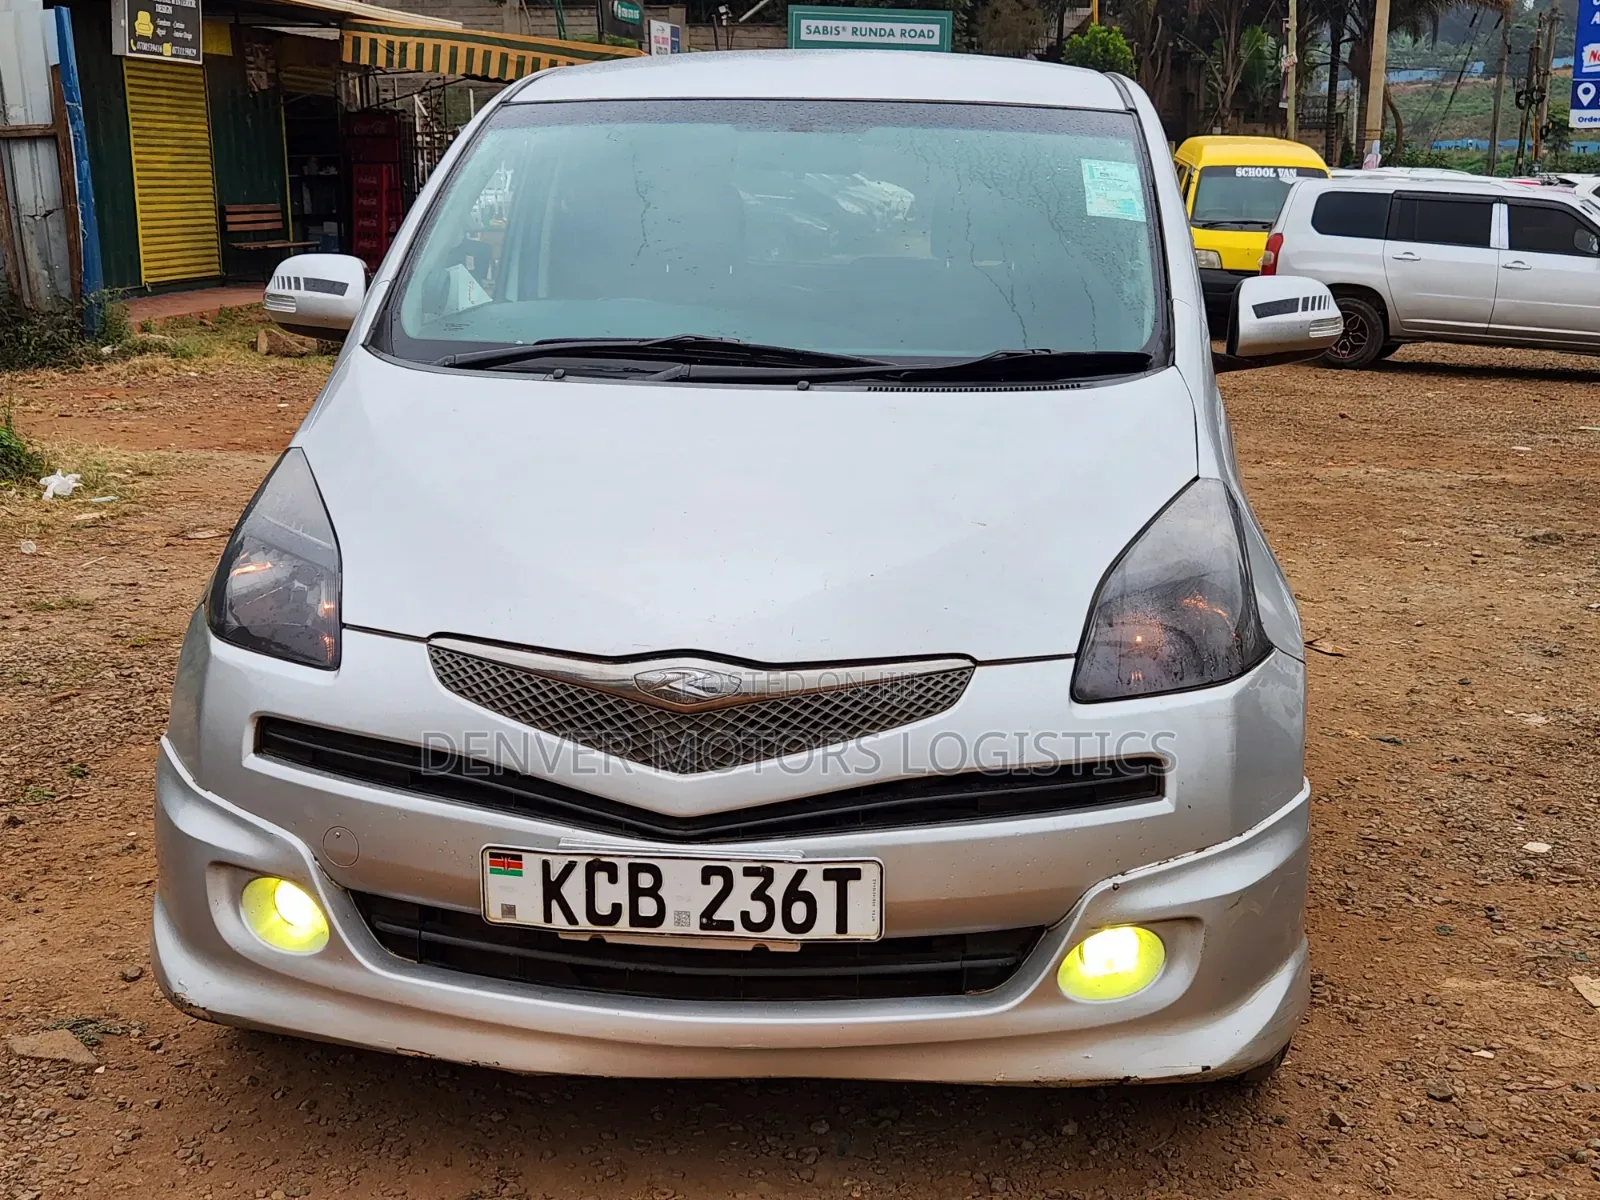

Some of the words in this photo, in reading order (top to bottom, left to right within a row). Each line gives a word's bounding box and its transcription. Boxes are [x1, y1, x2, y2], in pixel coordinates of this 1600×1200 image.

[851, 27, 896, 38] RUNDA
[900, 28, 935, 39] ROAD
[1235, 167, 1276, 178] SCHOOL
[1277, 168, 1297, 178] VAN
[541, 858, 666, 928] KCB
[699, 864, 862, 934] 236T
